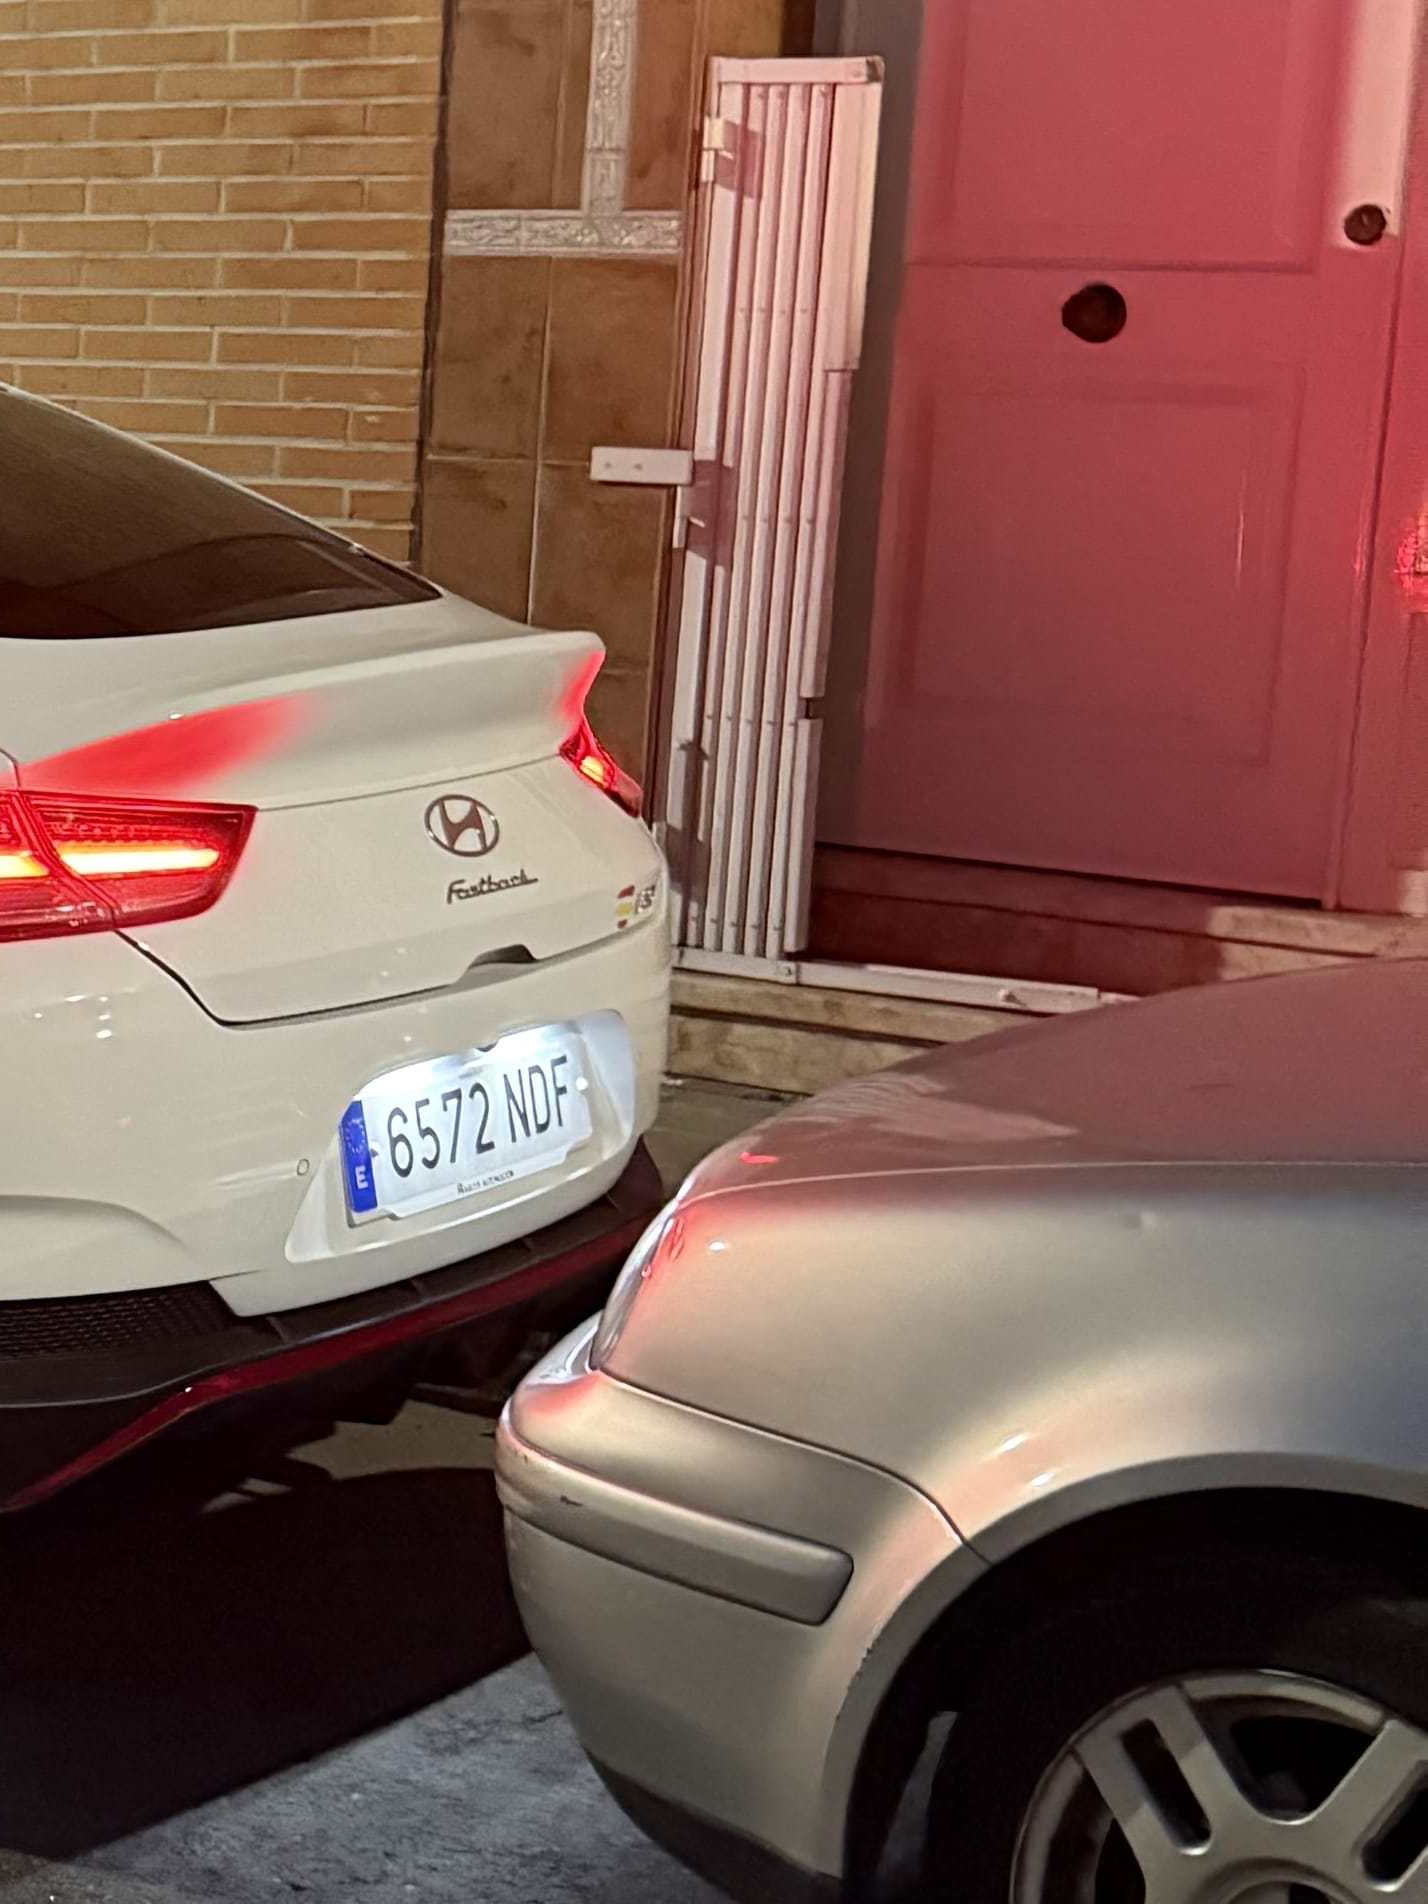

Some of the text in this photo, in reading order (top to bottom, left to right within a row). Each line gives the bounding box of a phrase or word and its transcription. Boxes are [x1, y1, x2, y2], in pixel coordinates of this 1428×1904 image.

[447, 869, 538, 904] Fastback
[387, 1055, 568, 1178] 6572 NDF
[354, 1165, 369, 1189] E
